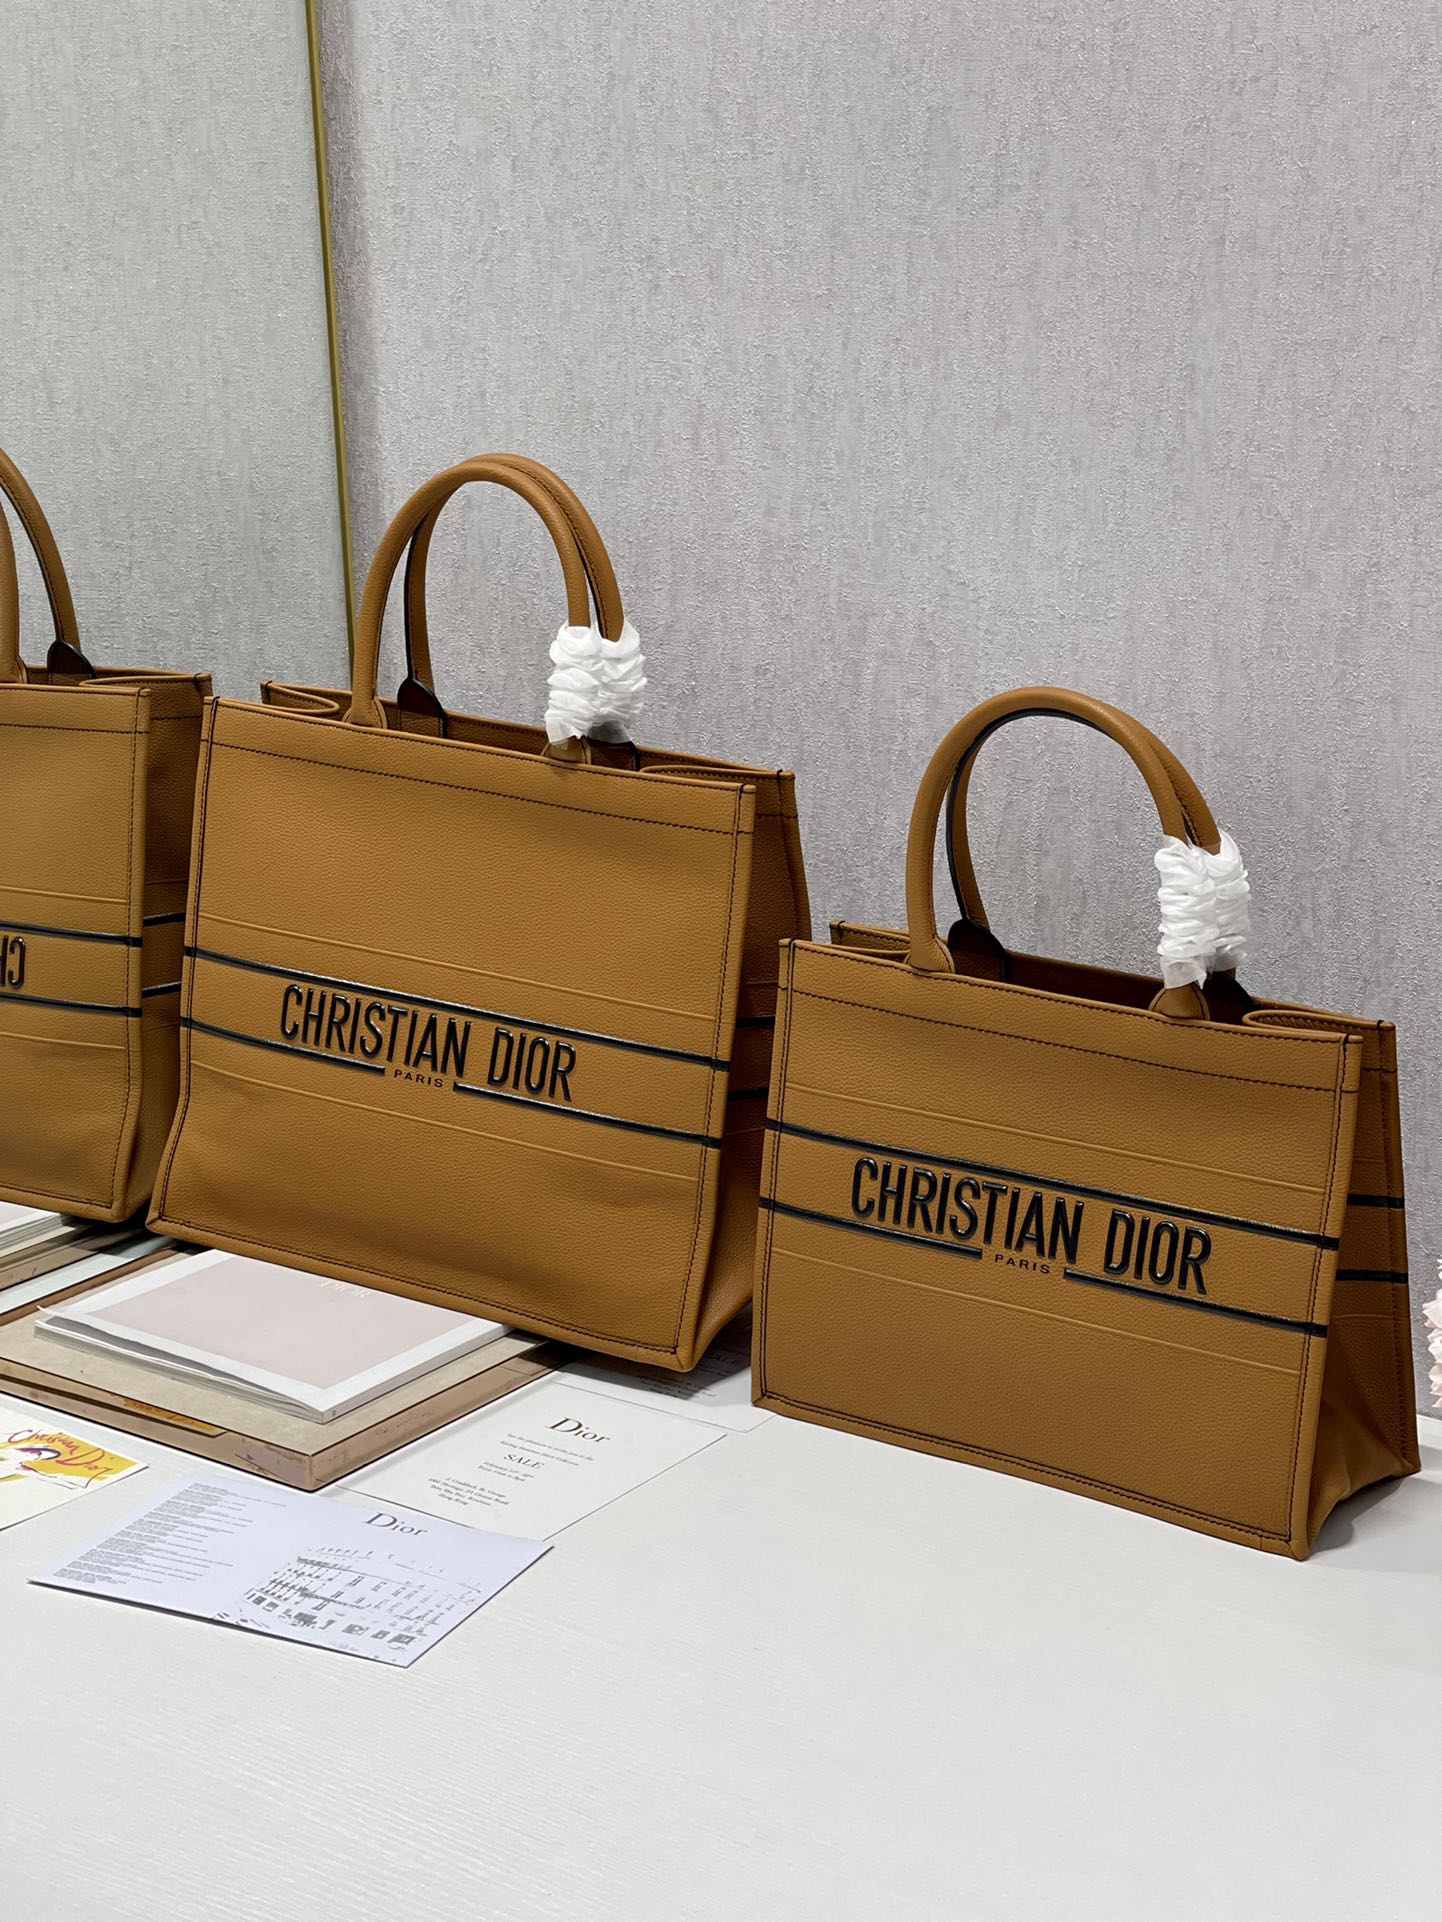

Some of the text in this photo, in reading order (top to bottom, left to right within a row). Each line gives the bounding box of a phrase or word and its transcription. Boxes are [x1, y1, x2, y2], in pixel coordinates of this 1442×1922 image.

[280, 984, 577, 1101] CHRISTIAN DIOR
[394, 1069, 443, 1088] PARIS
[851, 1157, 1212, 1295] CHRISTIAN DIOR
[994, 1253, 1051, 1275] PARIS
[545, 1417, 610, 1442] Dior
[504, 1453, 544, 1470] SALE
[362, 1512, 428, 1536] Dior
